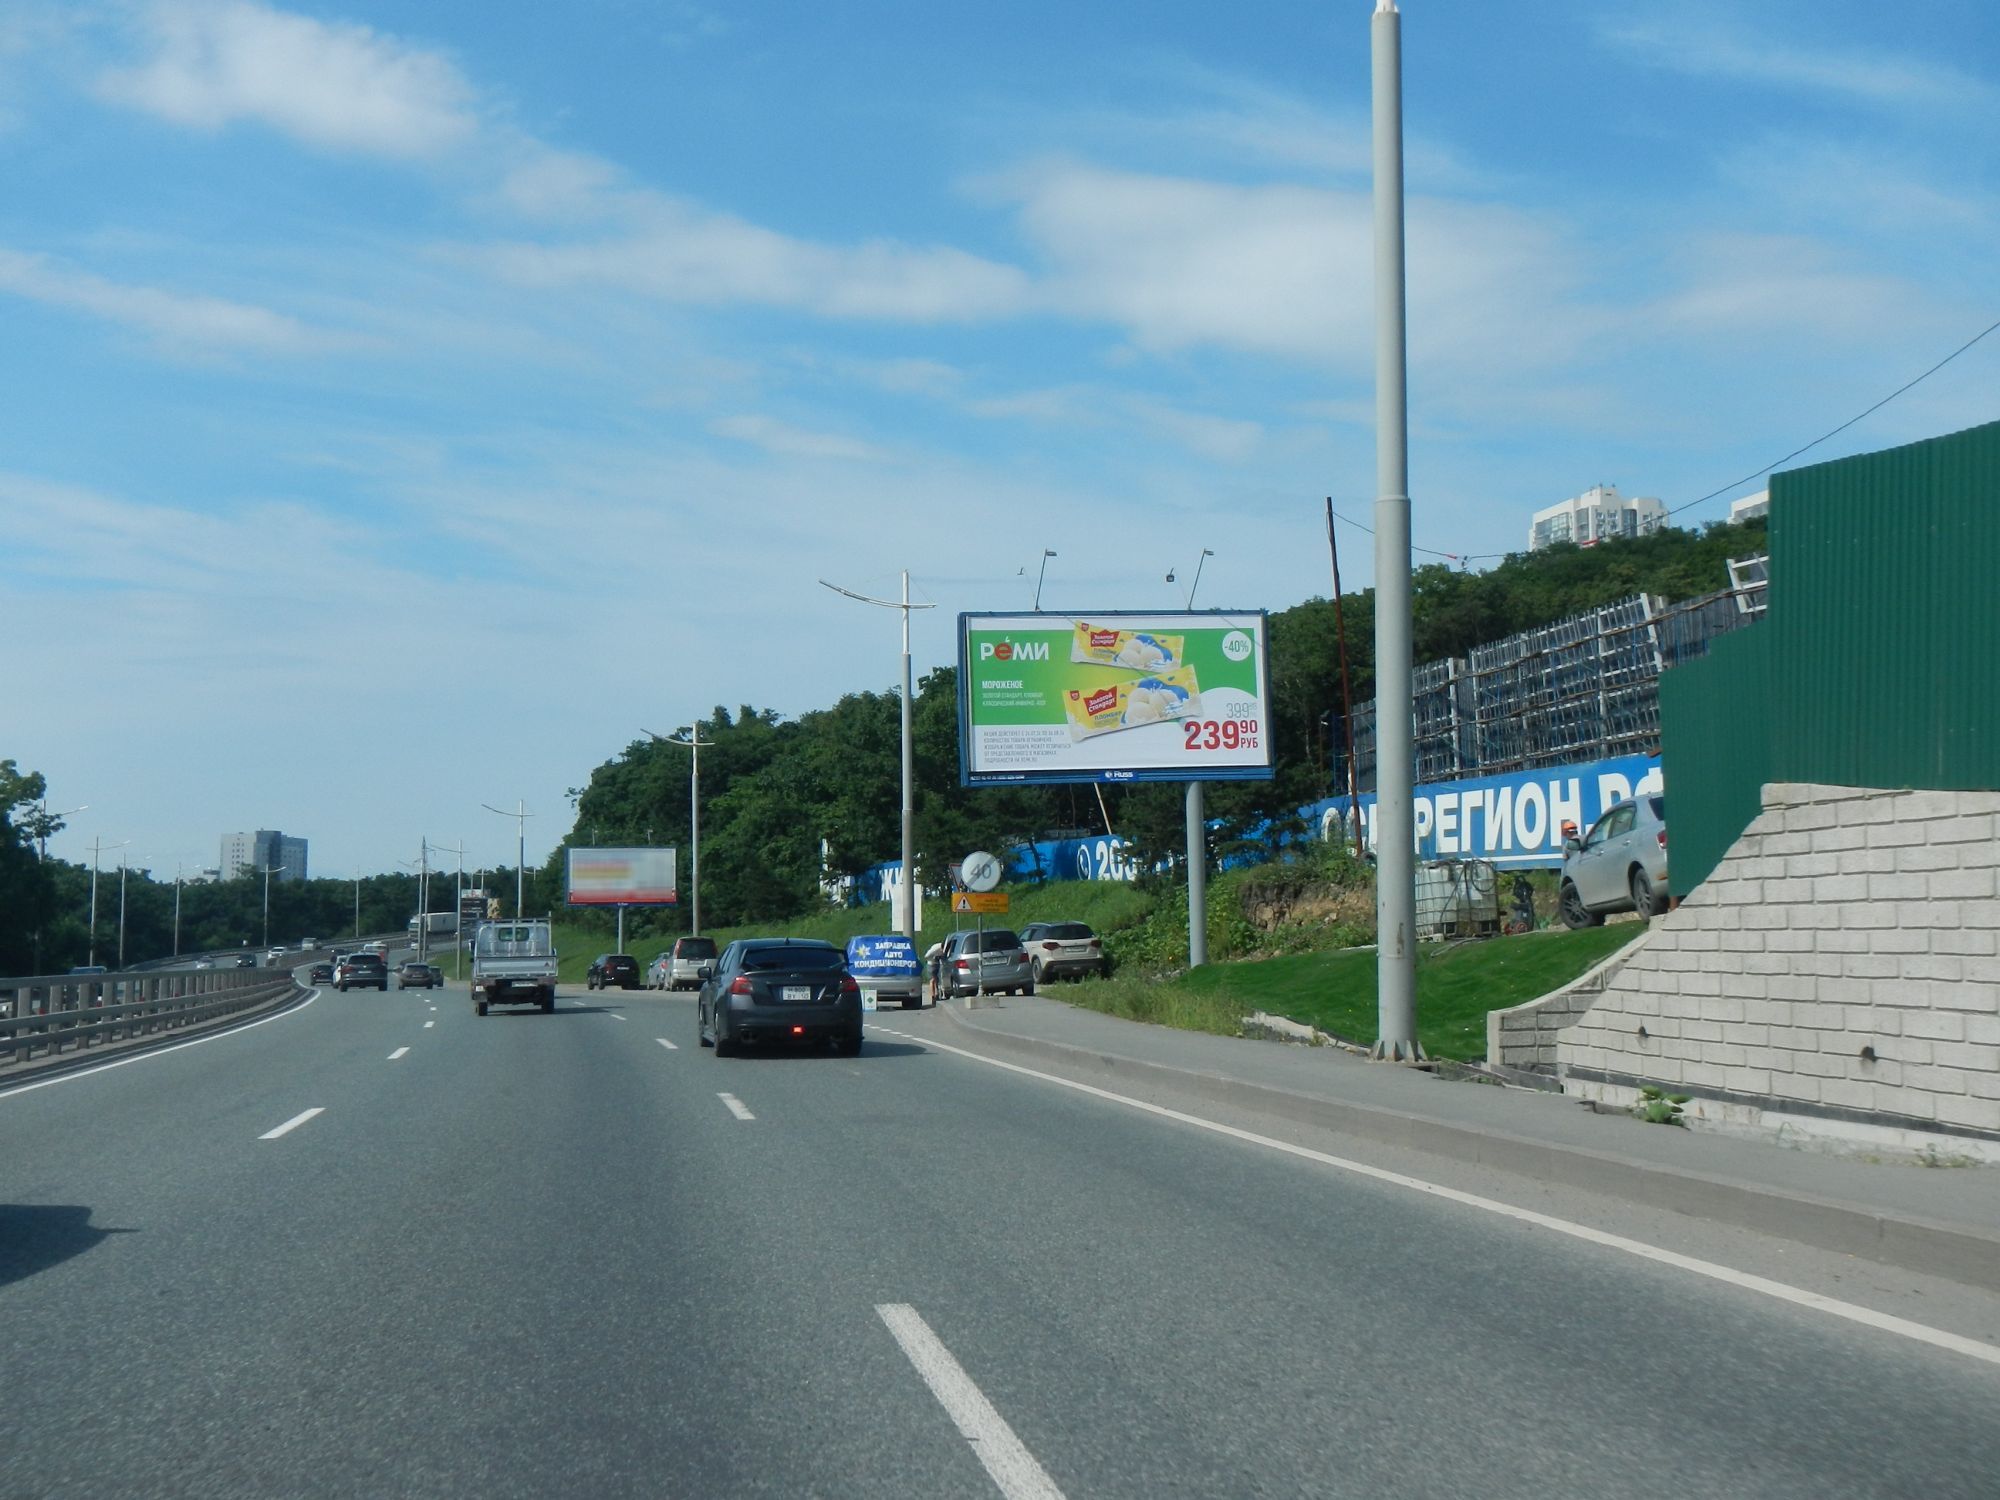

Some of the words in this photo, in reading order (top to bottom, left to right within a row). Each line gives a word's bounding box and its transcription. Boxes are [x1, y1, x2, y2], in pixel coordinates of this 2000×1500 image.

[1224, 640, 1249, 653] -40%
[982, 680, 1023, 689] МОРОЖЕНОЕ
[1184, 720, 1240, 750] 239
[1240, 720, 1258, 734] 90
[1240, 737, 1259, 749] РУБ
[970, 863, 992, 879] 40
[875, 942, 911, 950] ЗАПРАВКА
